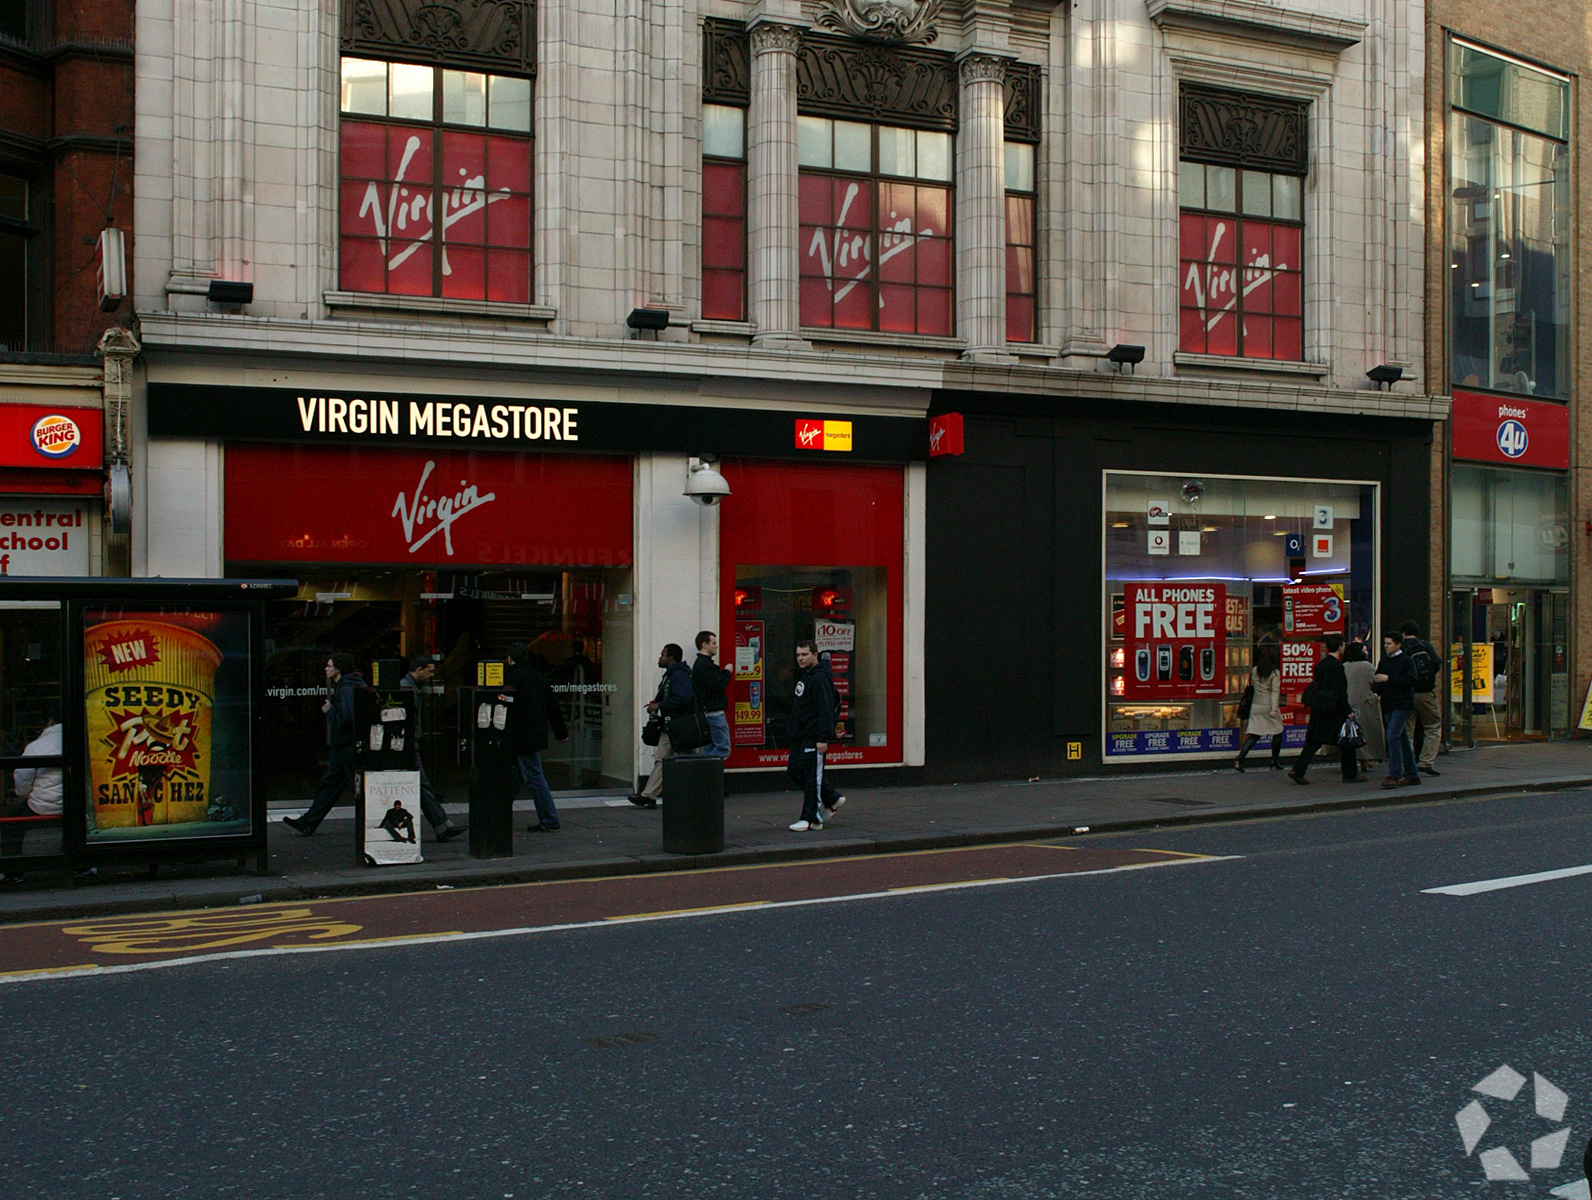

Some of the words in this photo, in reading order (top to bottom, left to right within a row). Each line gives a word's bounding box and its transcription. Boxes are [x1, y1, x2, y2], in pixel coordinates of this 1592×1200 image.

[359, 136, 511, 276] Virgin
[808, 183, 933, 308] Virgin
[1184, 222, 1288, 337] Virgin
[297, 397, 399, 434] VIRGIN
[409, 401, 579, 441] MEGASTORE
[1498, 404, 1526, 419] phones
[36, 422, 73, 438] BURGER
[799, 423, 822, 446] Virgin
[1500, 422, 1525, 455] 4u
[38, 430, 75, 449] KING
[391, 460, 496, 556] Virgin
[0, 508, 82, 527] entral
[1318, 509, 1328, 525] 3
[1135, 588, 1158, 602] ALL
[1162, 588, 1215, 602] PHONES
[1226, 598, 1239, 615] EST
[1323, 596, 1342, 623] 3
[1135, 603, 1216, 638] FREE
[1226, 615, 1243, 631] EALS
[111, 639, 147, 664] NEW
[1282, 643, 1314, 657] 50%
[1282, 663, 1313, 677] FREE
[104, 686, 201, 710] SEEDY
[1115, 740, 1135, 748] FREE
[1147, 738, 1167, 746] FREE
[1180, 737, 1199, 745] FREE
[1211, 736, 1230, 744] FREE
[129, 750, 183, 767] Noodle
[1069, 744, 1080, 757] H
